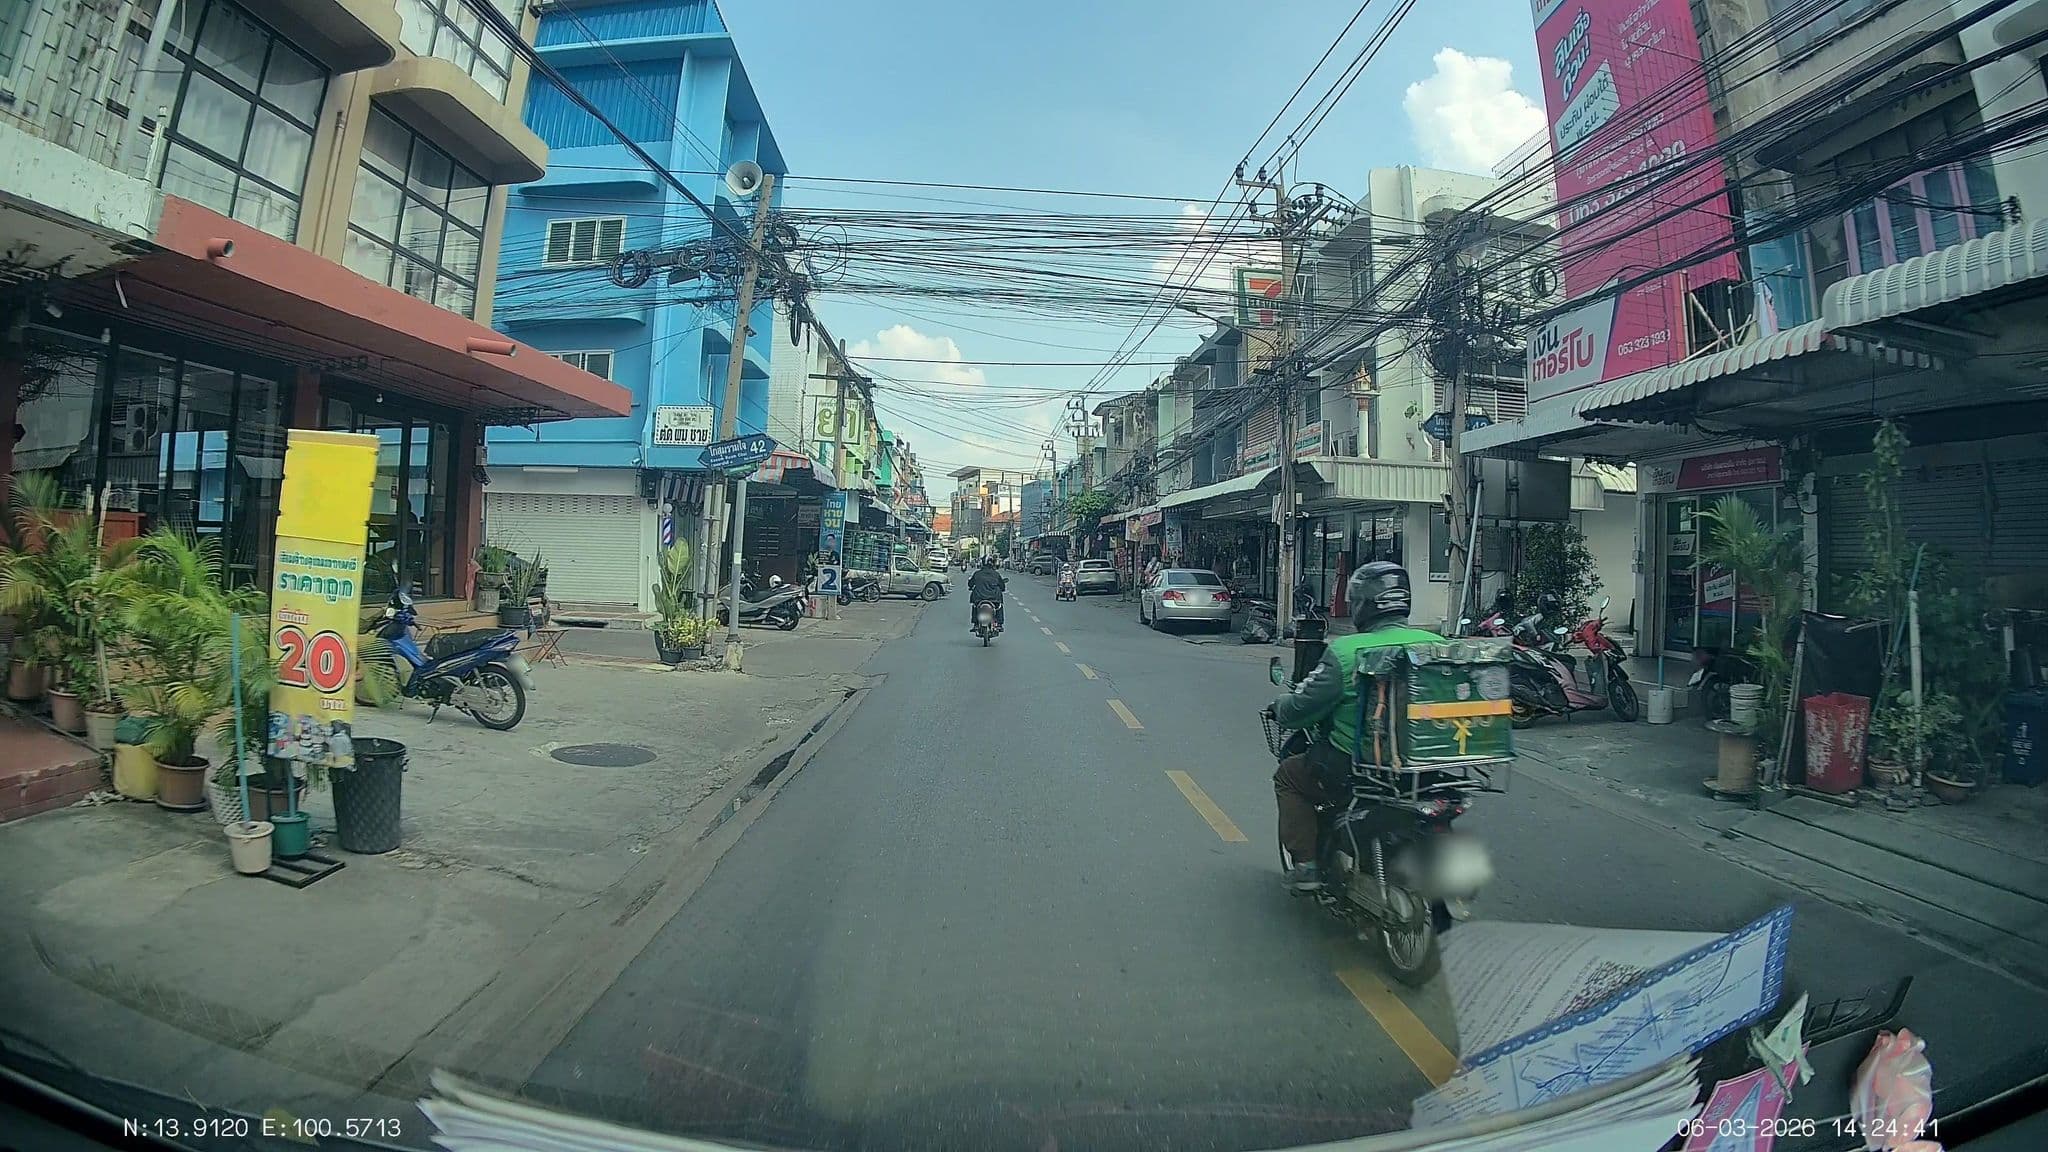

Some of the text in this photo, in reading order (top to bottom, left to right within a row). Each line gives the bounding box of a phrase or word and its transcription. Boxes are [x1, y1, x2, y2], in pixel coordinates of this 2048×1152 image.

[1563, 34, 1591, 102] ด่วน!
[1560, 111, 1582, 139] ประกัน
[1532, 327, 1594, 382] เทอร์โบ
[1533, 322, 1559, 359] เงิน
[659, 424, 673, 441] ตัด
[690, 428, 708, 441] ชาย
[750, 440, 767, 454] 42
[279, 571, 354, 602] ราคาถูก
[821, 568, 837, 591] 2
[275, 625, 351, 694] 20
